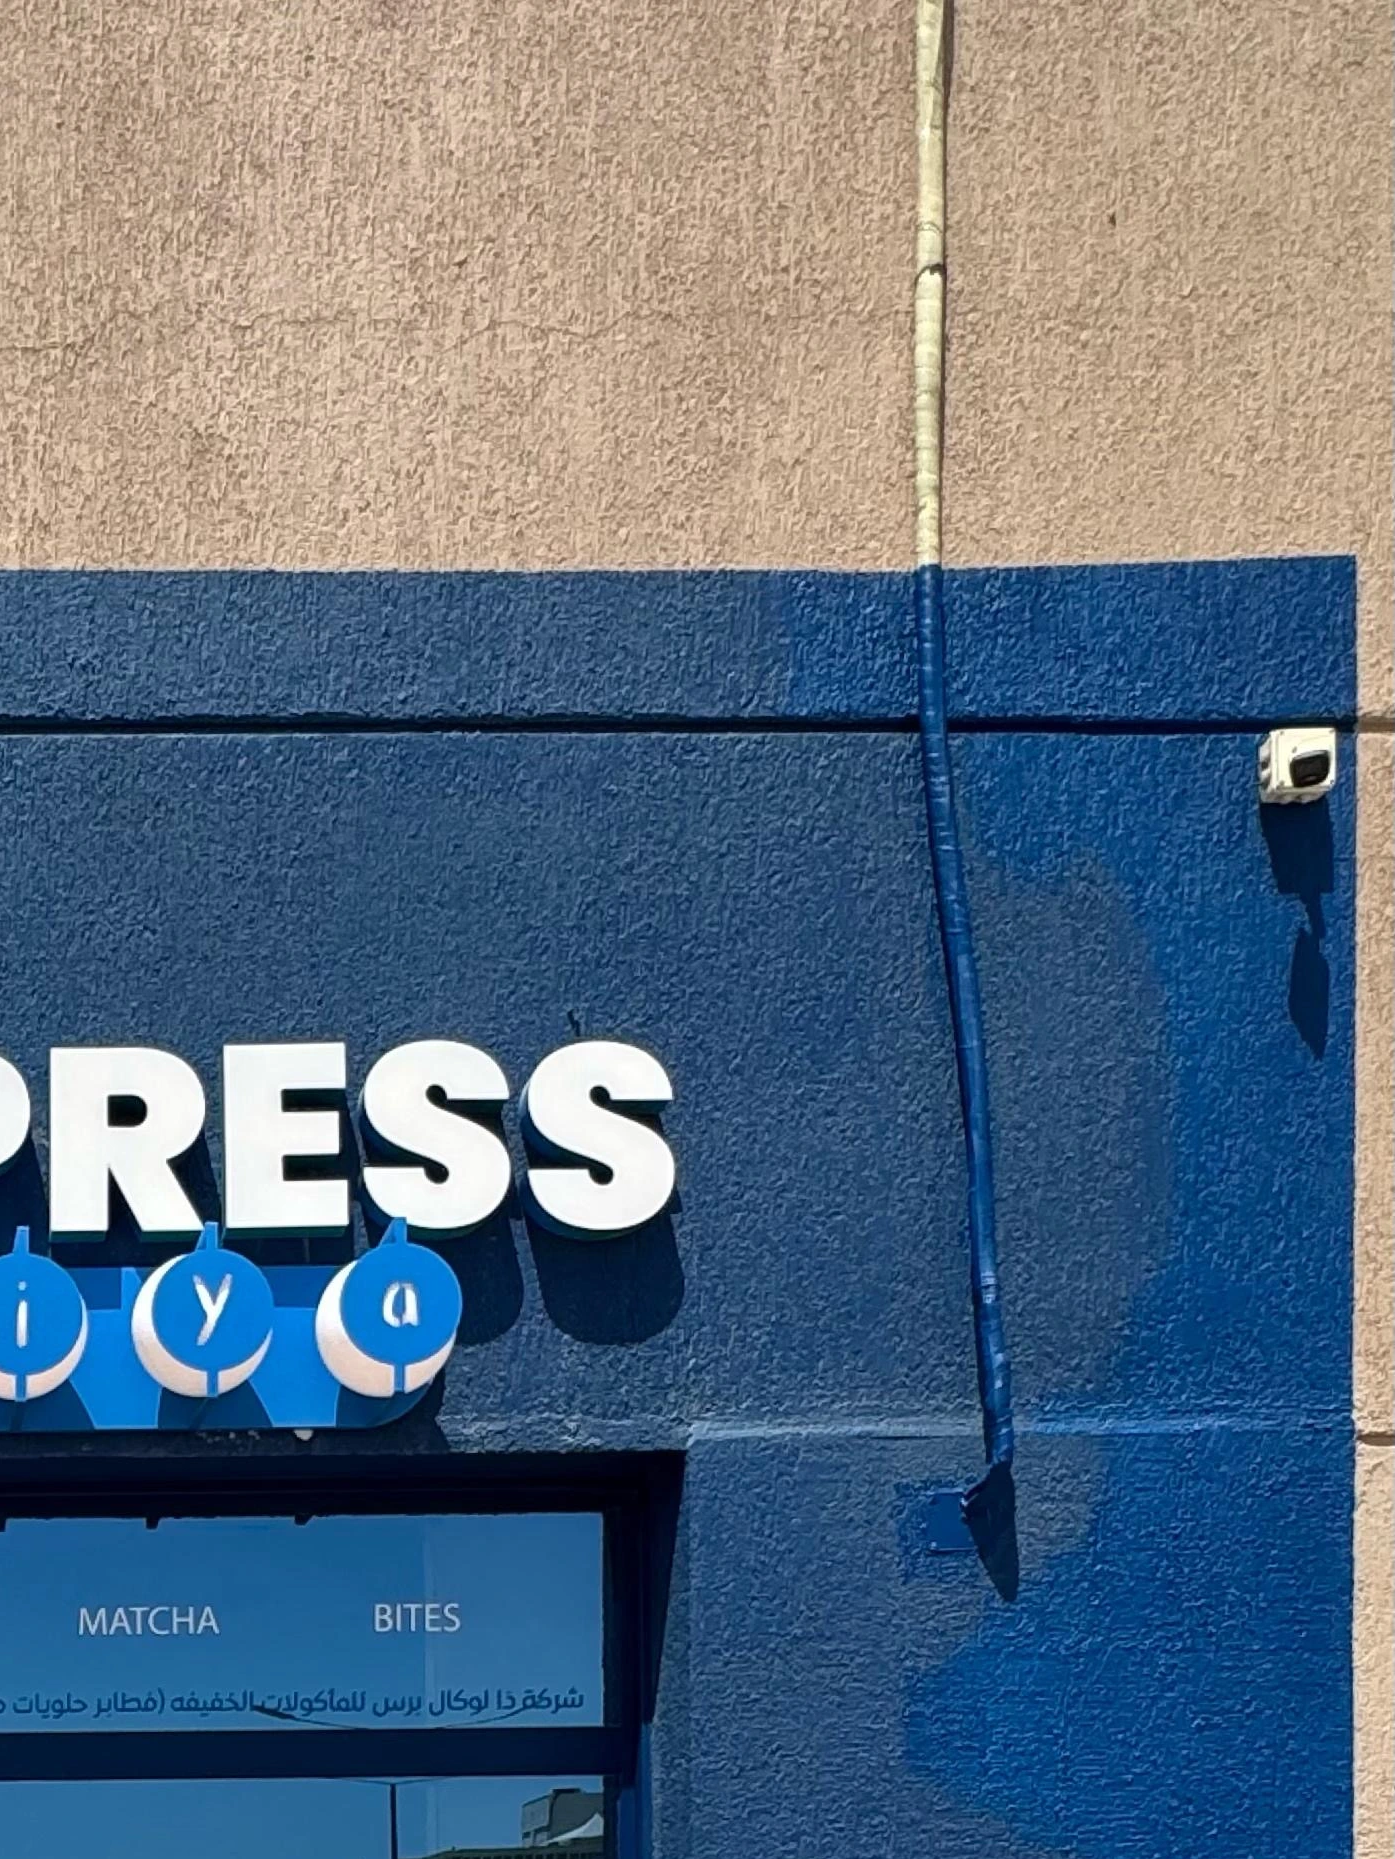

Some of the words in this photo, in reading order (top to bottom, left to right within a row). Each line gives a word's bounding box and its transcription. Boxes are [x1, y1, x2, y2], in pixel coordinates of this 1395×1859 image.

[77, 1604, 221, 1638] MATCHA
[373, 1602, 462, 1634] BITES
[12, 1691, 88, 1720] حلويات
[372, 1694, 422, 1718] برس
[428, 1687, 489, 1717] لوكال
[521, 1685, 585, 1714] شركة
